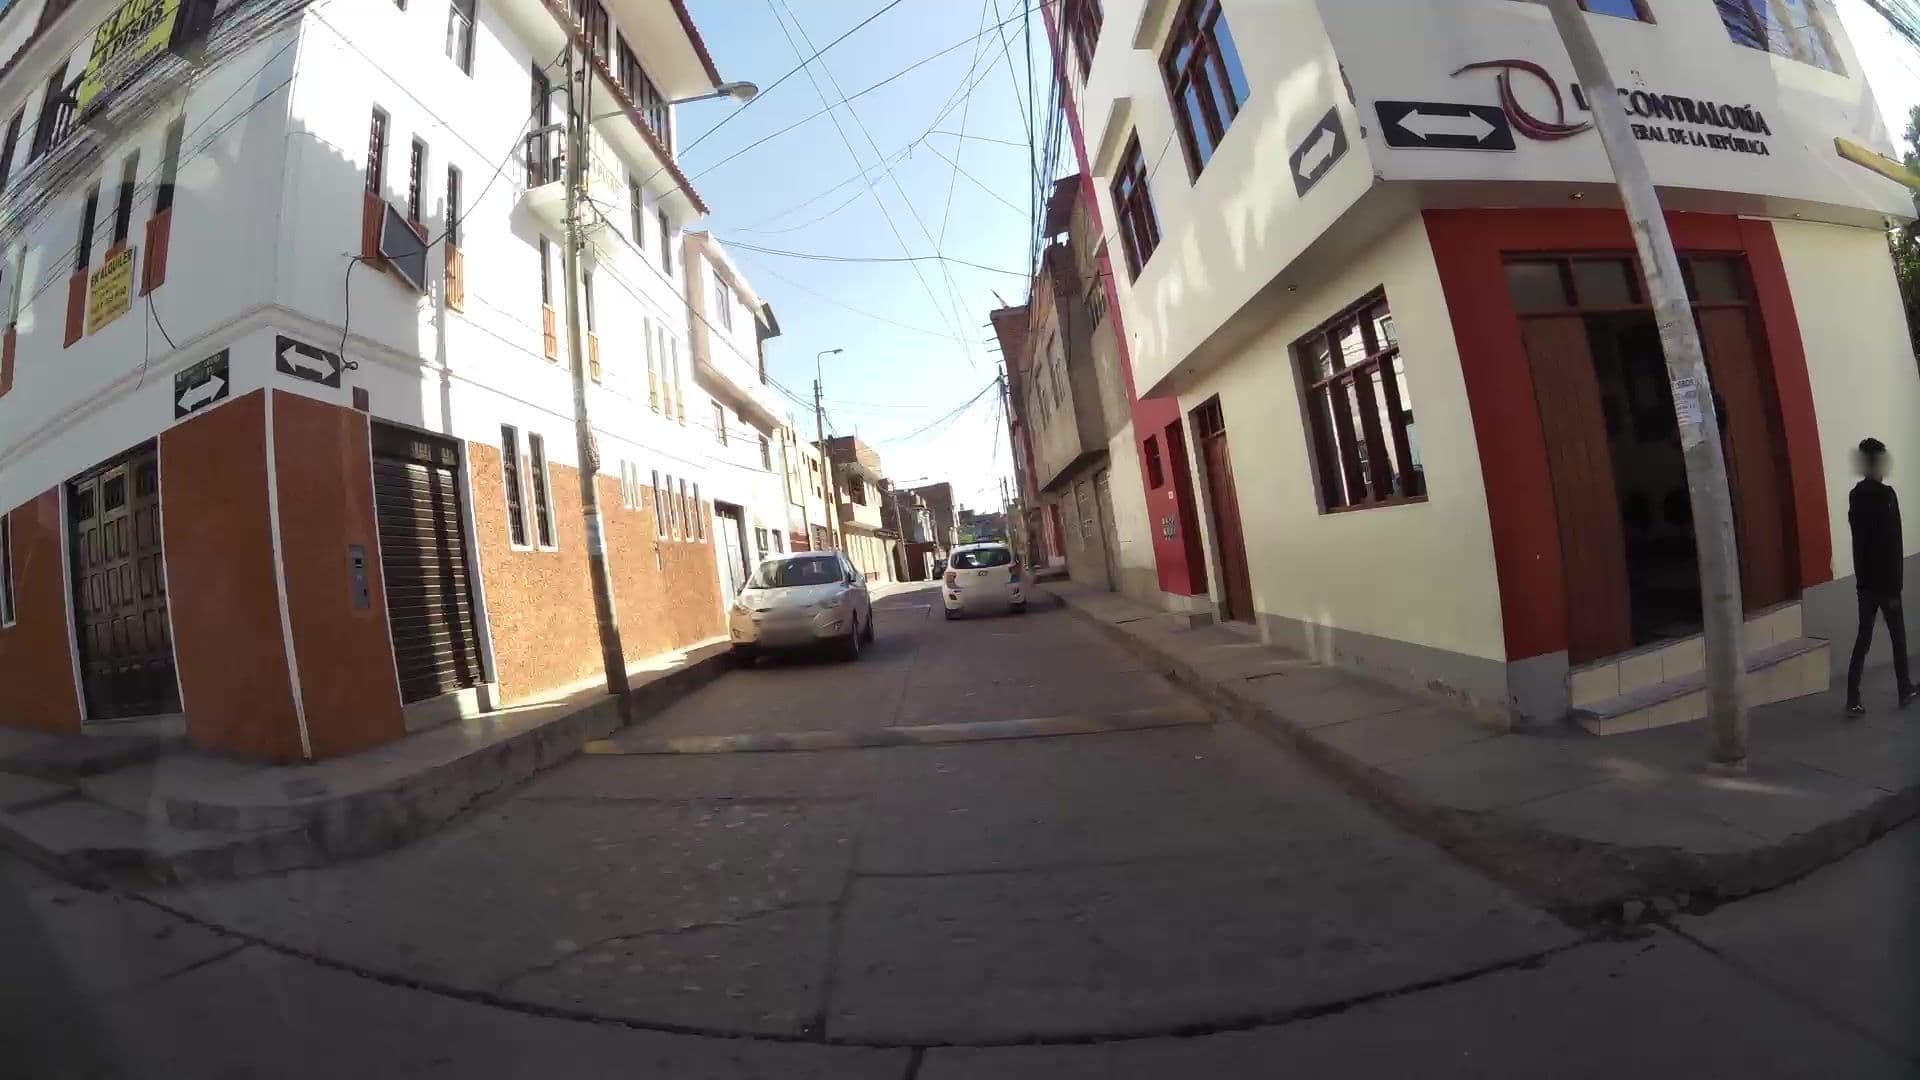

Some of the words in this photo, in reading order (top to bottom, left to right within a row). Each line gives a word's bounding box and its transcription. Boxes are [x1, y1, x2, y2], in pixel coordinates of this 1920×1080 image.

[1668, 127, 1689, 145] DE
[1688, 130, 1707, 148] LA
[1706, 133, 1770, 156] REPÚBLICA
